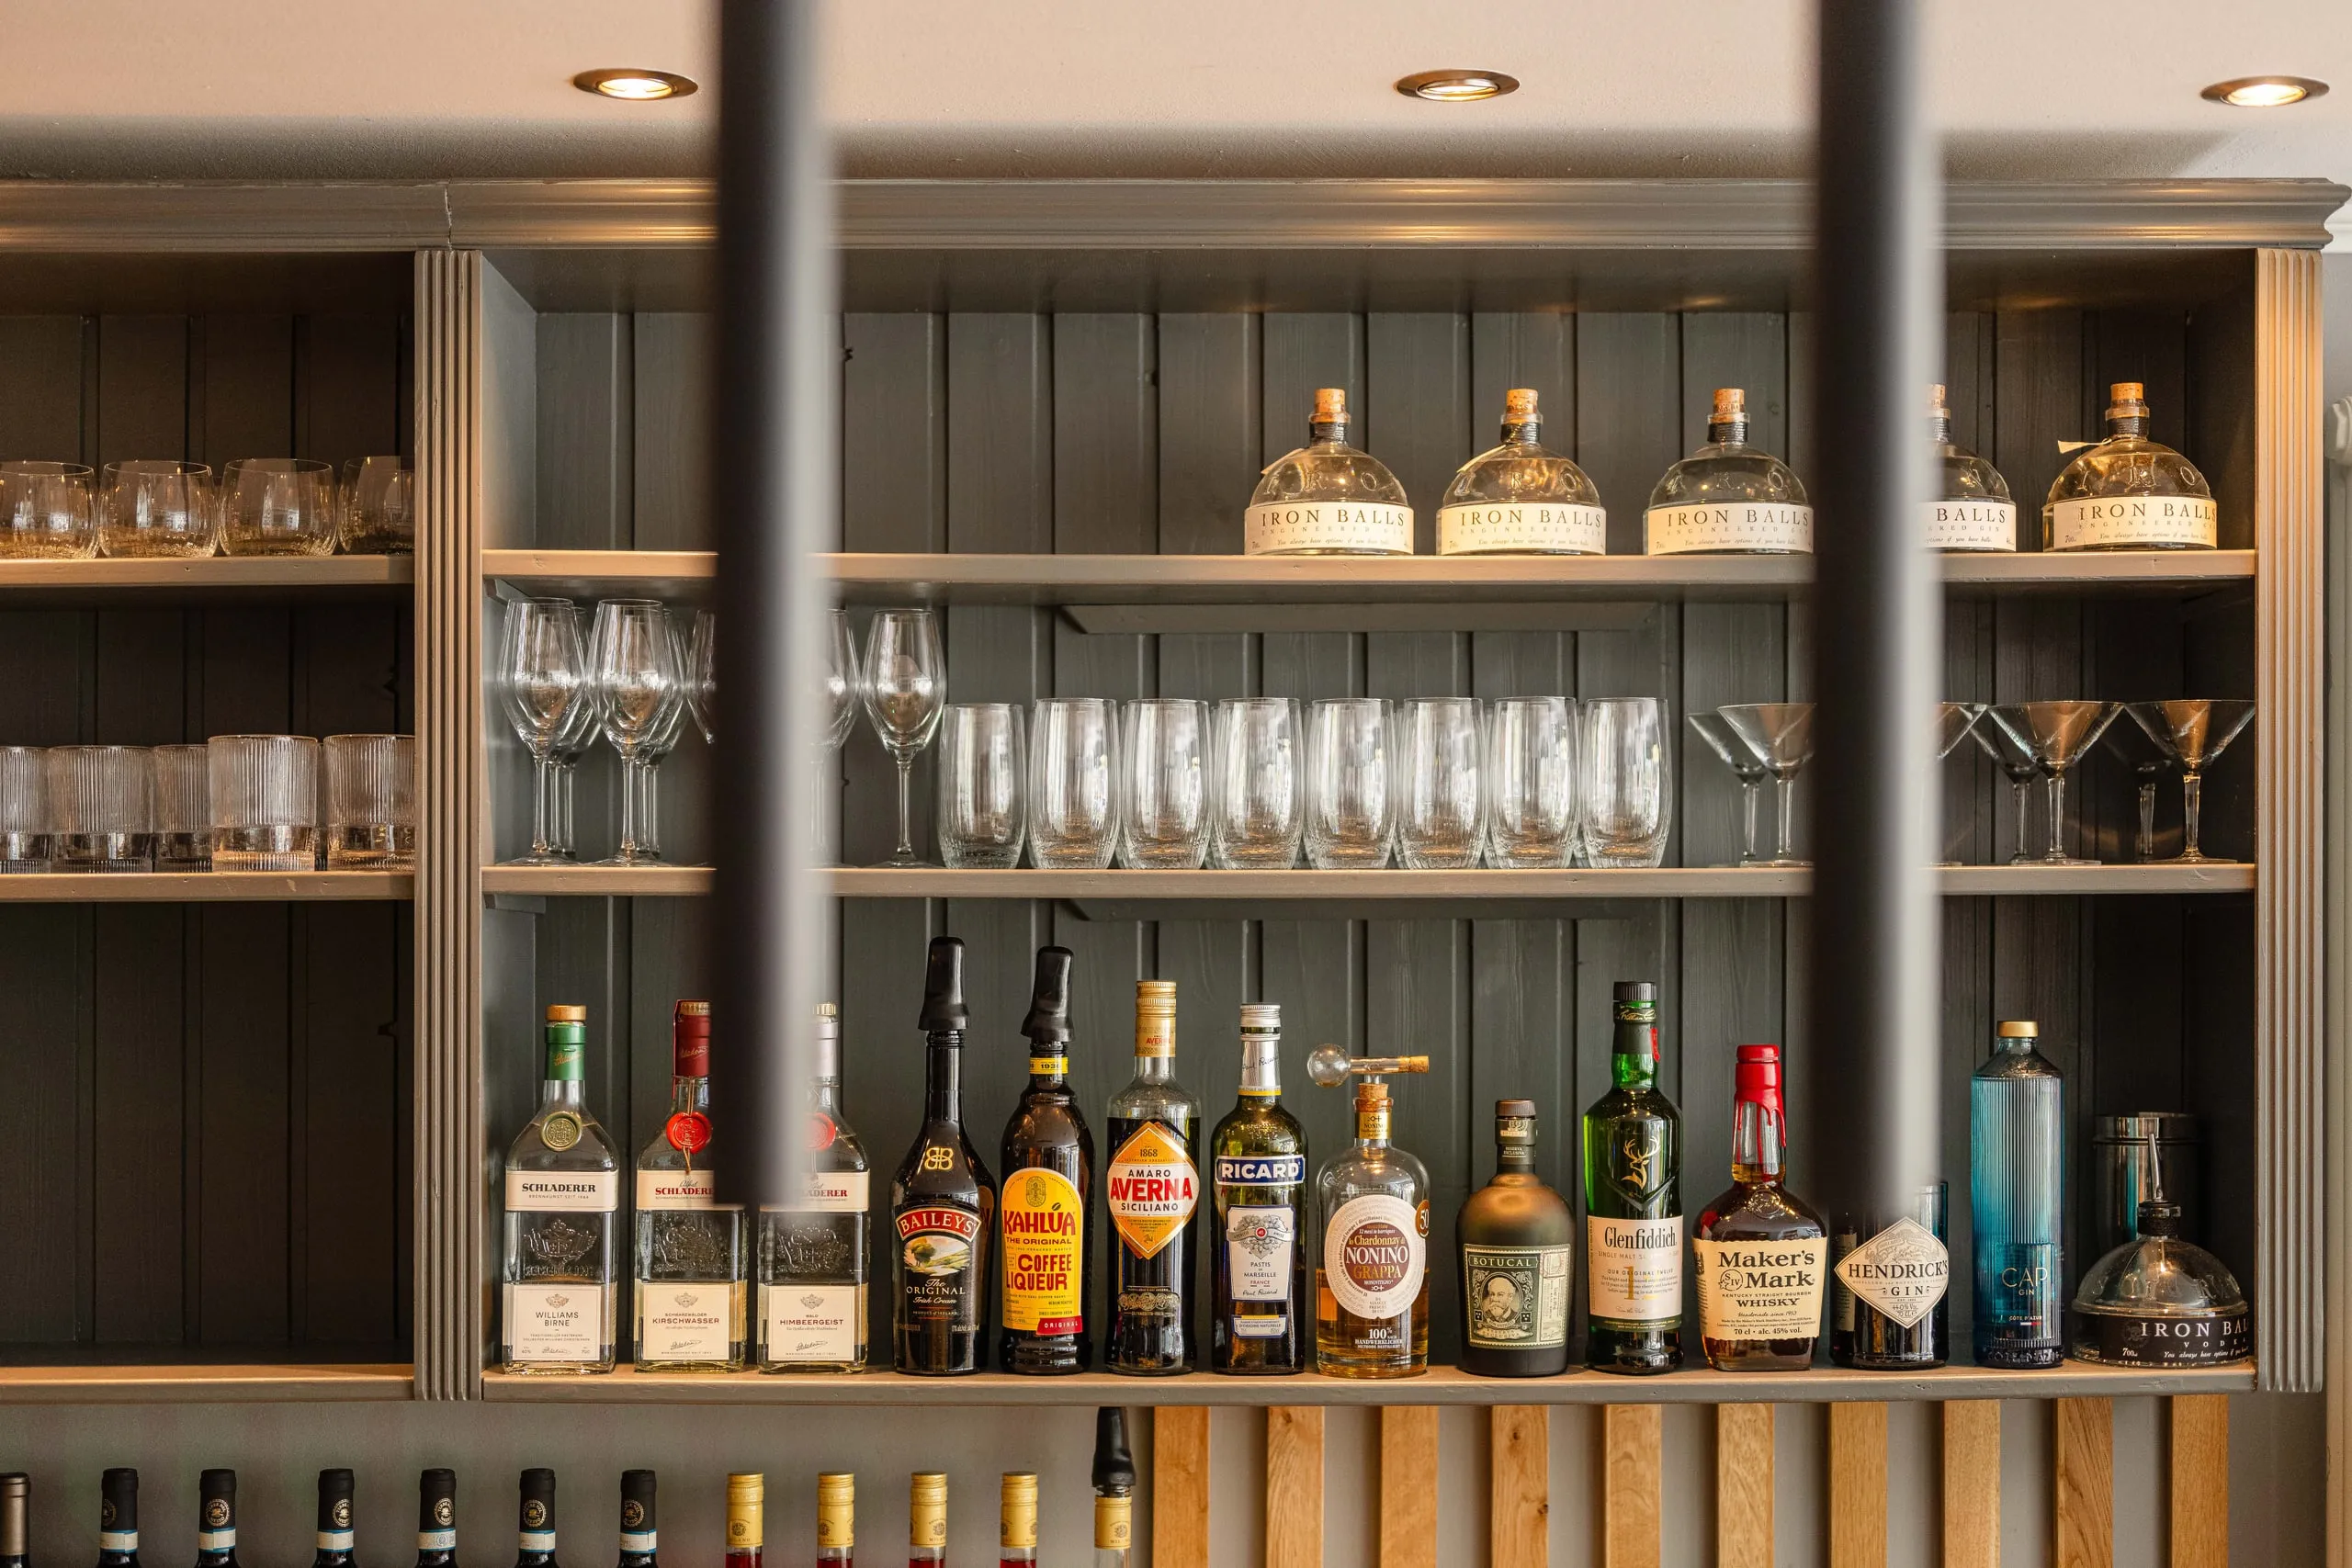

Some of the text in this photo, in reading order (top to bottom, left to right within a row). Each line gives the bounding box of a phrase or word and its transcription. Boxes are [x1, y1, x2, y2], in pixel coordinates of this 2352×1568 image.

[1262, 510, 1404, 526] IRON BALLS
[1461, 510, 1601, 527] IRON BALLS
[1668, 510, 1808, 526] IRON BALLS
[1936, 508, 2006, 524] BALLS
[2080, 503, 2216, 522] IRON BALLS
[1139, 1148, 1158, 1157] 1868
[1128, 1169, 1171, 1178] AMARO
[1221, 1163, 1298, 1179] RICARD
[522, 1183, 596, 1192] SCHLADERER
[655, 1187, 714, 1195] SCHLADERE
[1110, 1177, 1193, 1201] AVERNA
[1121, 1202, 1179, 1212] SICILIANO
[900, 1213, 974, 1233] BAILEYS
[1354, 1235, 1401, 1247] Chardonnay
[1604, 1226, 1676, 1249] Glenfiddich
[1346, 1246, 1408, 1265] NONINO
[1598, 1250, 1617, 1258] SINGLE
[1717, 1250, 1815, 1268] Maker's
[1018, 1254, 1072, 1272] COFFEE
[1473, 1258, 1532, 1267] BOTUCAL
[1848, 1259, 1948, 1279] HENDRICK'S
[1006, 1270, 1068, 1291] LIQUEUR
[1353, 1265, 1402, 1280] GRAPPA
[1745, 1270, 1815, 1289] Mark
[2001, 1267, 2048, 1288] CAP
[906, 1286, 966, 1295] ORIGINAL
[924, 1279, 946, 1287] The
[1891, 1285, 1924, 1296] GIN
[933, 1296, 957, 1304] Cream
[1736, 1297, 1800, 1308] WHISKY
[2141, 1318, 2248, 1337] IRON BAL
